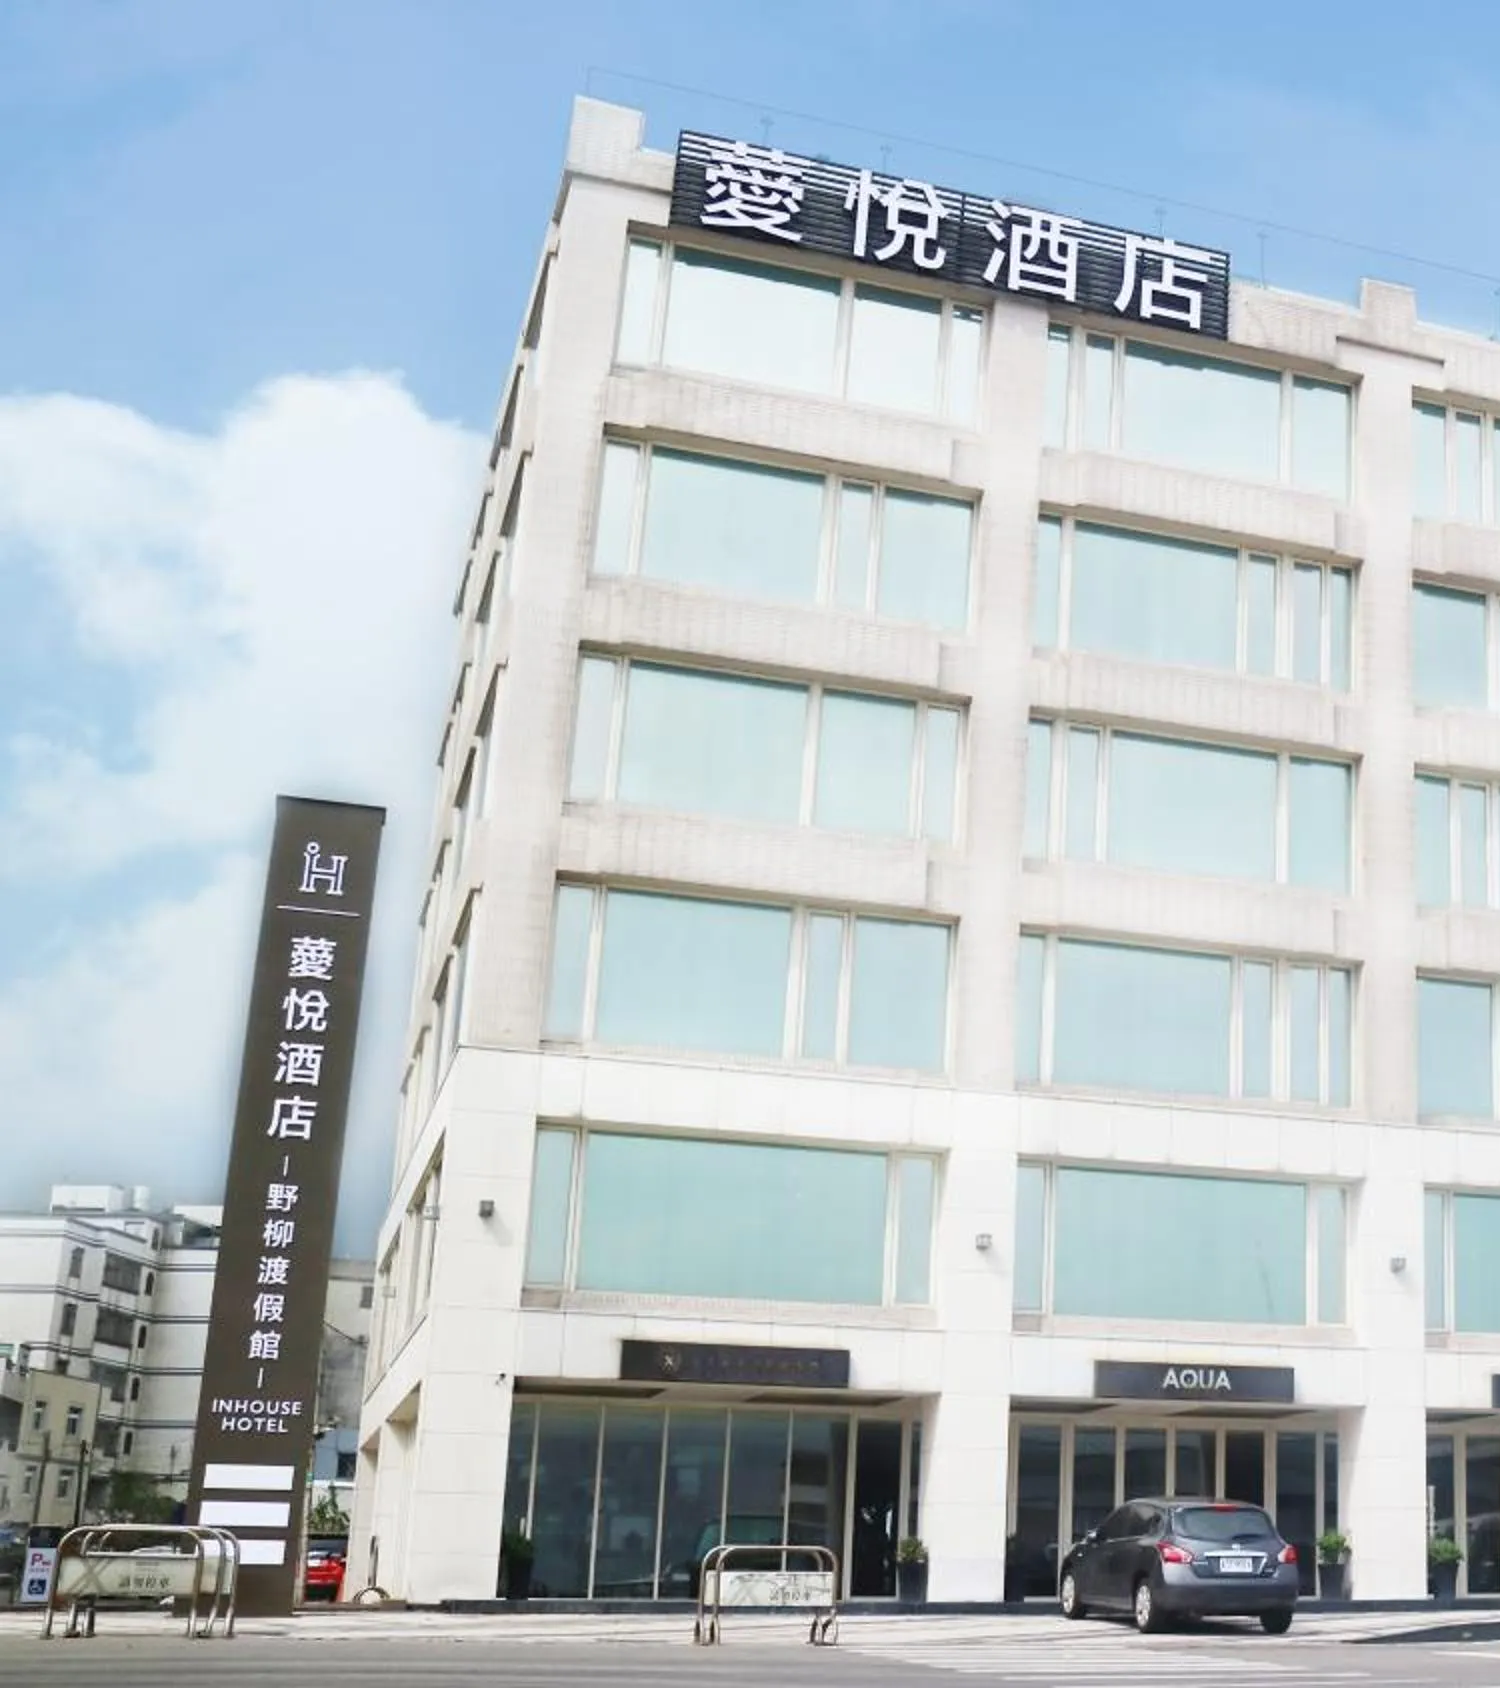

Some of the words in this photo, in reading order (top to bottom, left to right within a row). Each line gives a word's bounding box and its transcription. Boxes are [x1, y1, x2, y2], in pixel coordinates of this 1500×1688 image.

[1162, 1367, 1232, 1391] AQUA
[211, 1397, 303, 1415] INHOUSE
[221, 1416, 289, 1433] HOTEL
